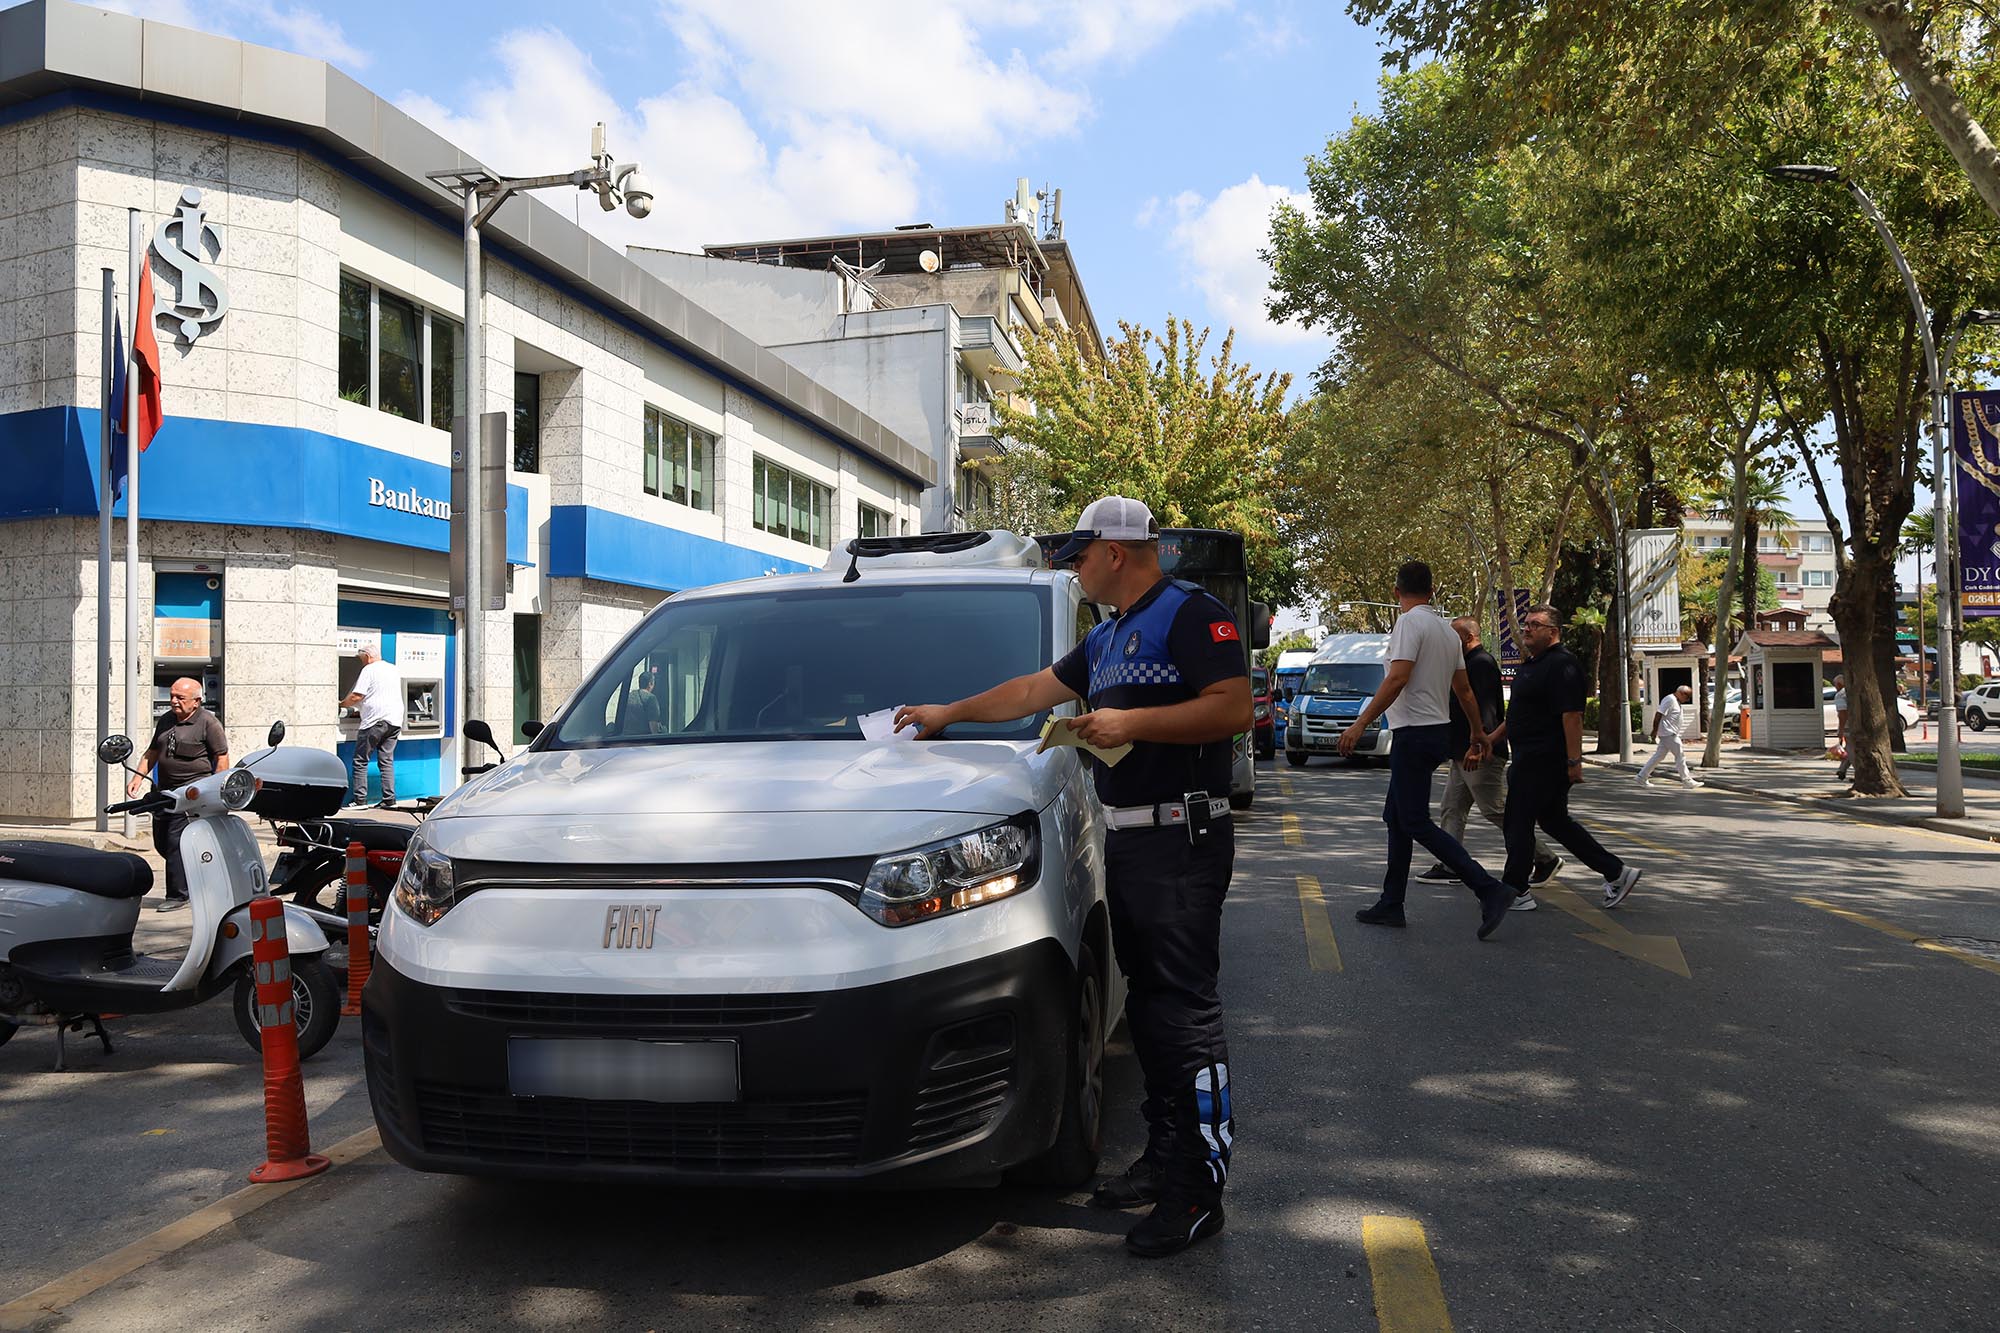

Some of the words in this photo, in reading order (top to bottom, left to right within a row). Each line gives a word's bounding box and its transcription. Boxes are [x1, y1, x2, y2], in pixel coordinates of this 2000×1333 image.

[1965, 567, 1991, 581] DY
[1968, 594, 1994, 603] 0264
[1634, 623, 1647, 632] DY
[1649, 623, 1678, 631] GOLD
[603, 905, 662, 949] FIAT
